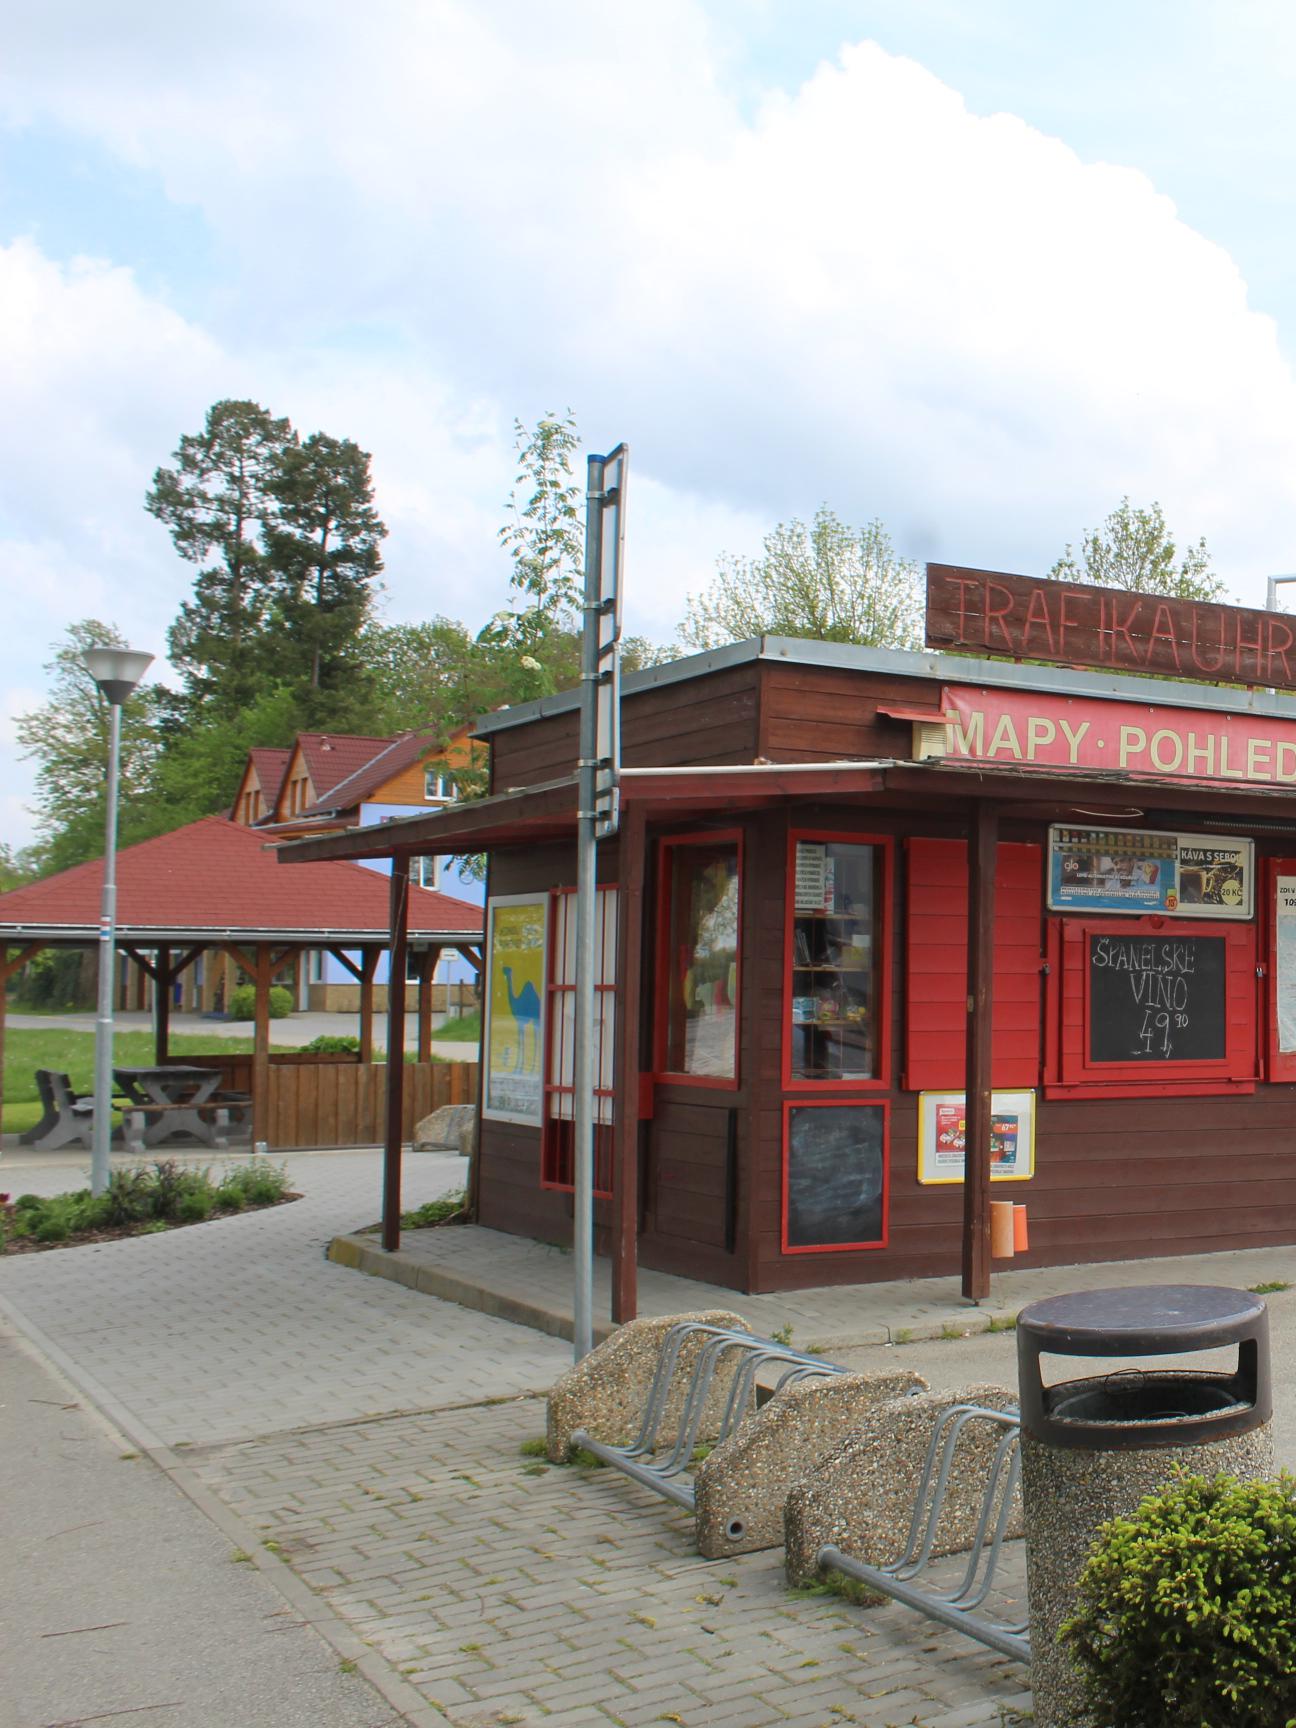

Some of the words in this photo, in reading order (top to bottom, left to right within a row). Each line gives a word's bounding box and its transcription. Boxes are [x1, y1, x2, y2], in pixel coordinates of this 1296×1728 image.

[945, 576, 1182, 669] TRAFIKA
[945, 709, 1091, 764] MAPY
[1181, 848, 1205, 860] KÁVA
[1206, 851, 1213, 861] S
[1221, 888, 1230, 896] 20
